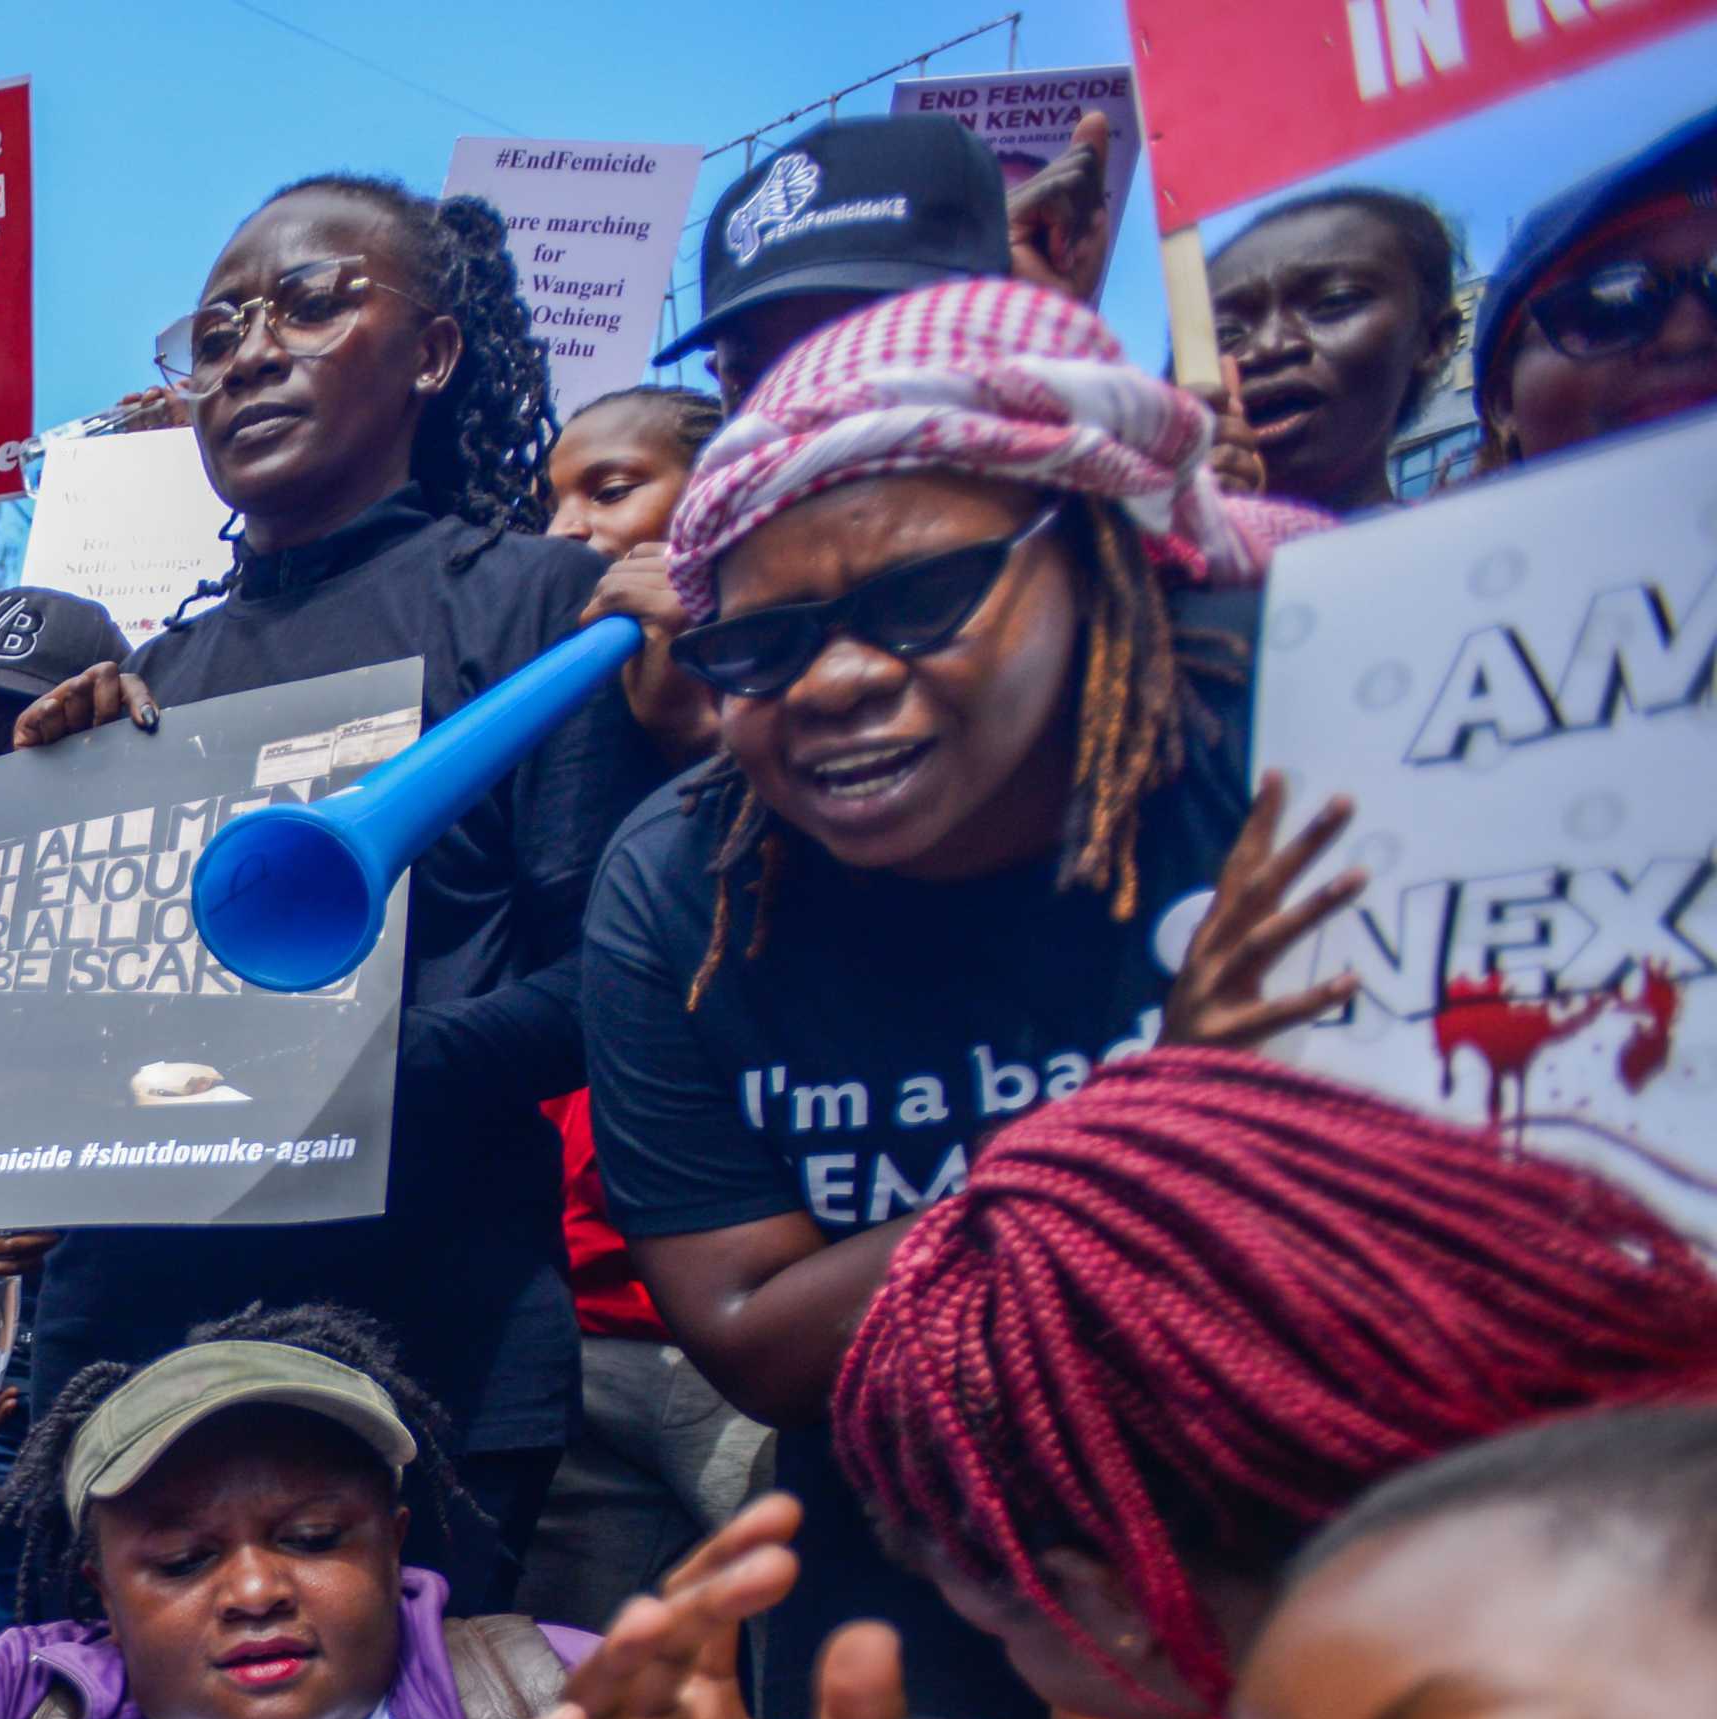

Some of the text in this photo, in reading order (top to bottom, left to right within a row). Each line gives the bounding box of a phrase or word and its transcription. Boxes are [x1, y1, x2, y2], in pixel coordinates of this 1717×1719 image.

[918, 79, 1129, 111] END FEMICIDE
[986, 105, 1083, 131] KENYA
[496, 148, 657, 175] #EndFemicide
[507, 215, 651, 241] are marching
[762, 198, 907, 243] #EndFemicideKE
[533, 244, 566, 263] for
[533, 273, 625, 301] Wangari
[532, 304, 622, 333] Ochieng
[35, 816, 153, 870] ALL
[26, 902, 129, 951] ALL
[744, 1066, 869, 1130] I'm
[898, 1075, 949, 1123] a
[79, 1132, 357, 1168] #shutdownke-again
